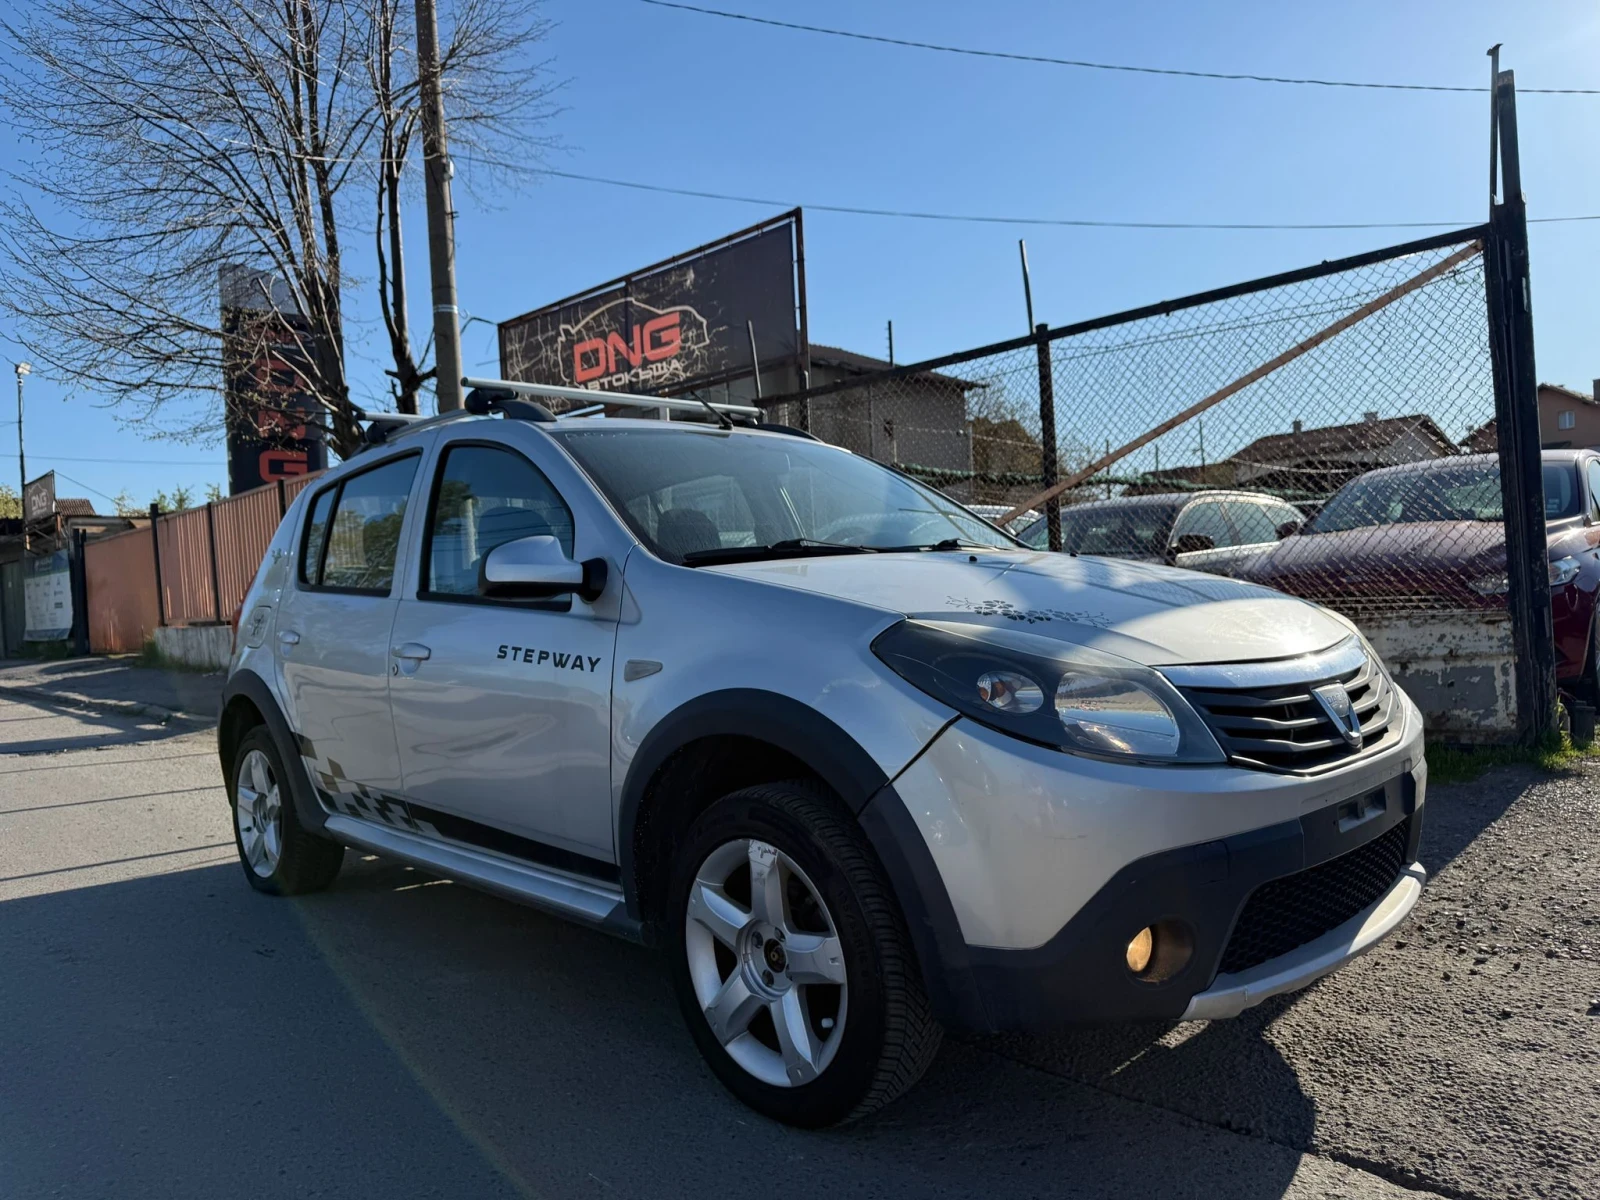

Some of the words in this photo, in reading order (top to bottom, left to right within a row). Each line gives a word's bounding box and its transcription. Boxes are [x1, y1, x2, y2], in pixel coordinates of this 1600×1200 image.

[573, 312, 682, 383] DNG
[31, 491, 47, 511] DNG
[497, 644, 601, 672] STEPWAY
